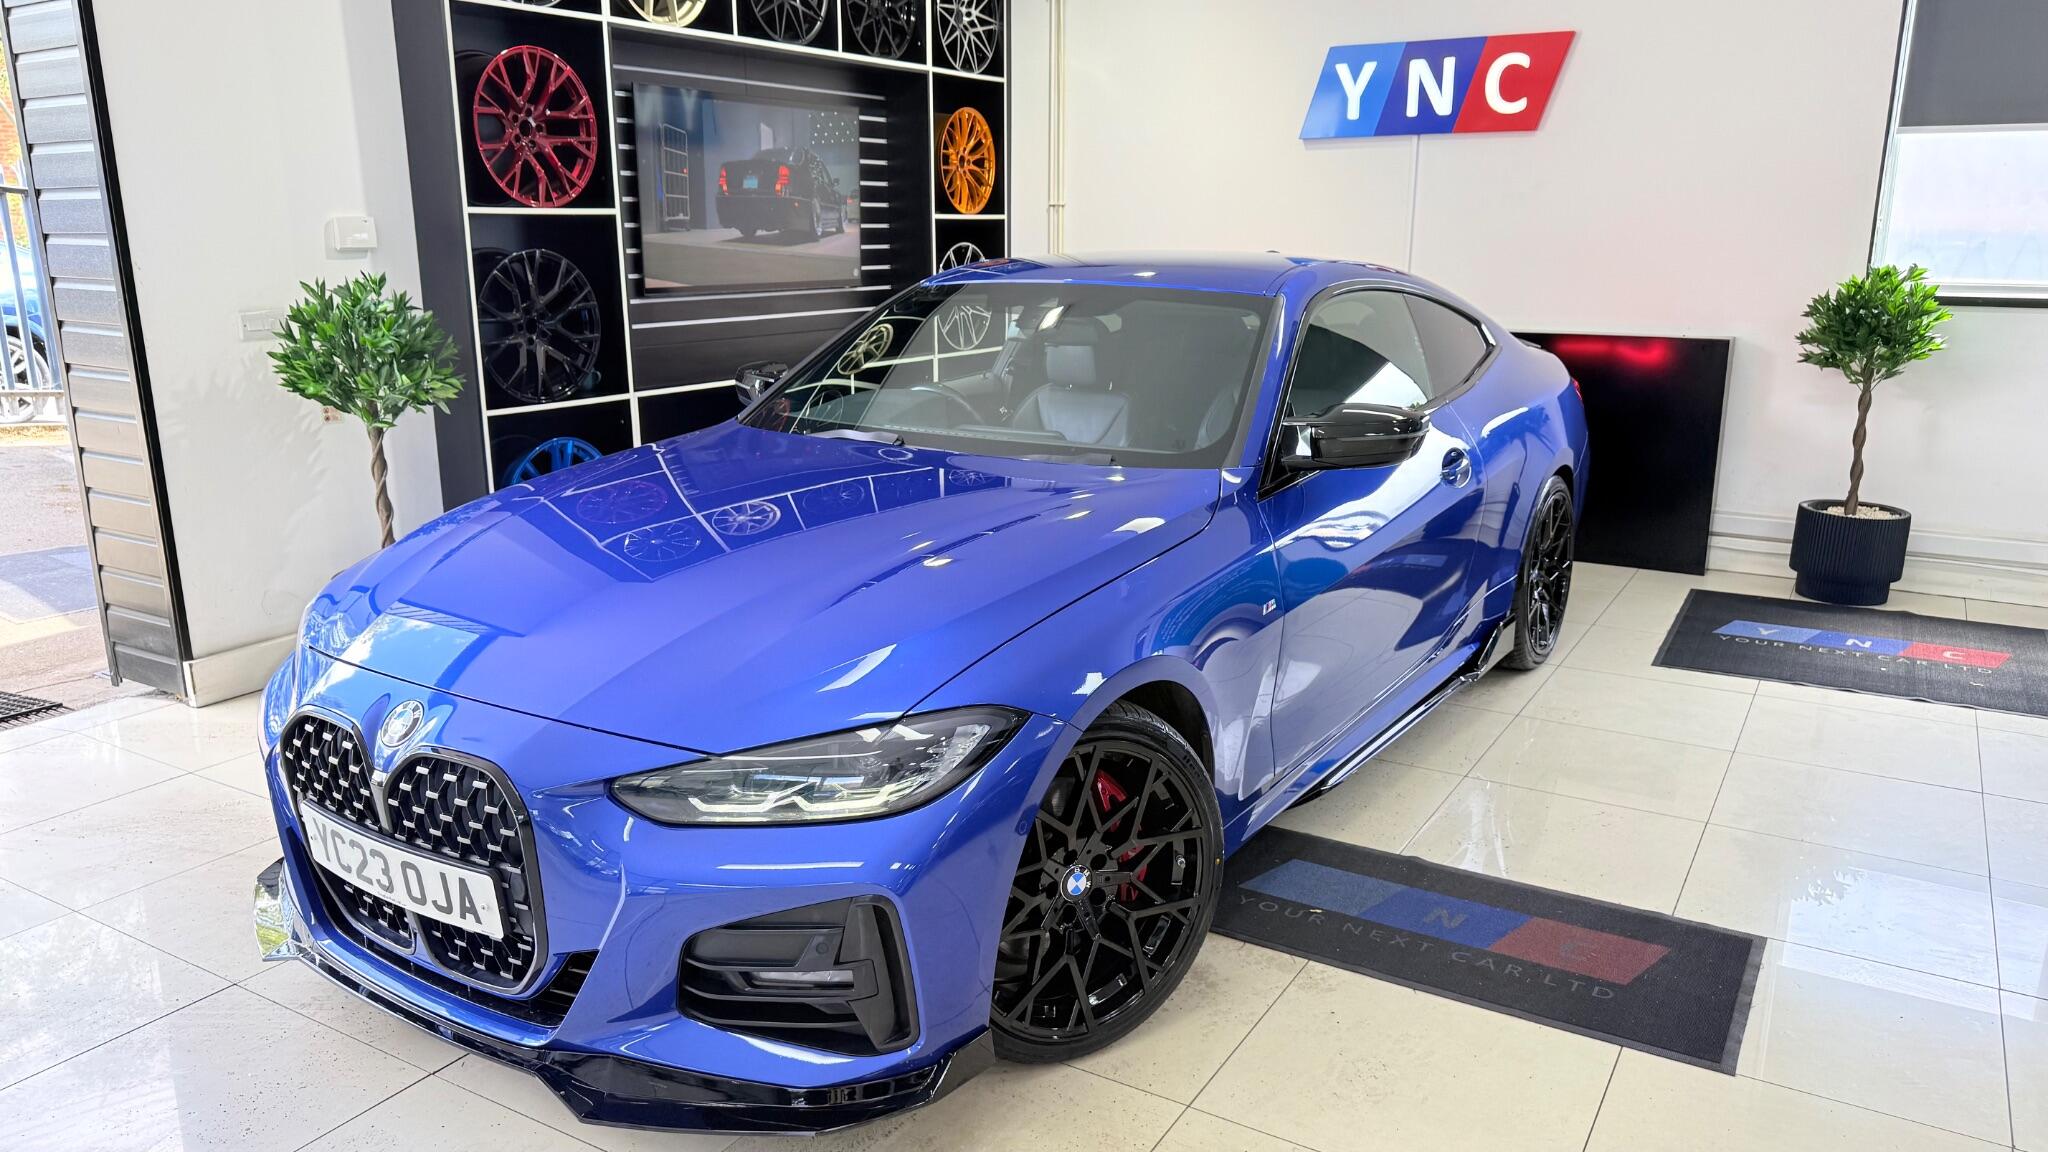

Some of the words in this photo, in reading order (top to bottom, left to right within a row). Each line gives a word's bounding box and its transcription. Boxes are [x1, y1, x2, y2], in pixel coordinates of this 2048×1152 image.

[1335, 52, 1531, 120] YNC
[1719, 634, 1785, 648] YOUR
[1799, 645, 1863, 657] NEXT
[1878, 654, 1928, 666] CAR
[1944, 663, 1992, 674] LTD
[313, 817, 395, 894] YC23
[400, 860, 483, 925] OJA
[1239, 895, 1325, 925] YOUR
[1342, 922, 1434, 951] NEXT
[1451, 952, 1522, 977] CAR
[1544, 974, 1615, 999] LTD
